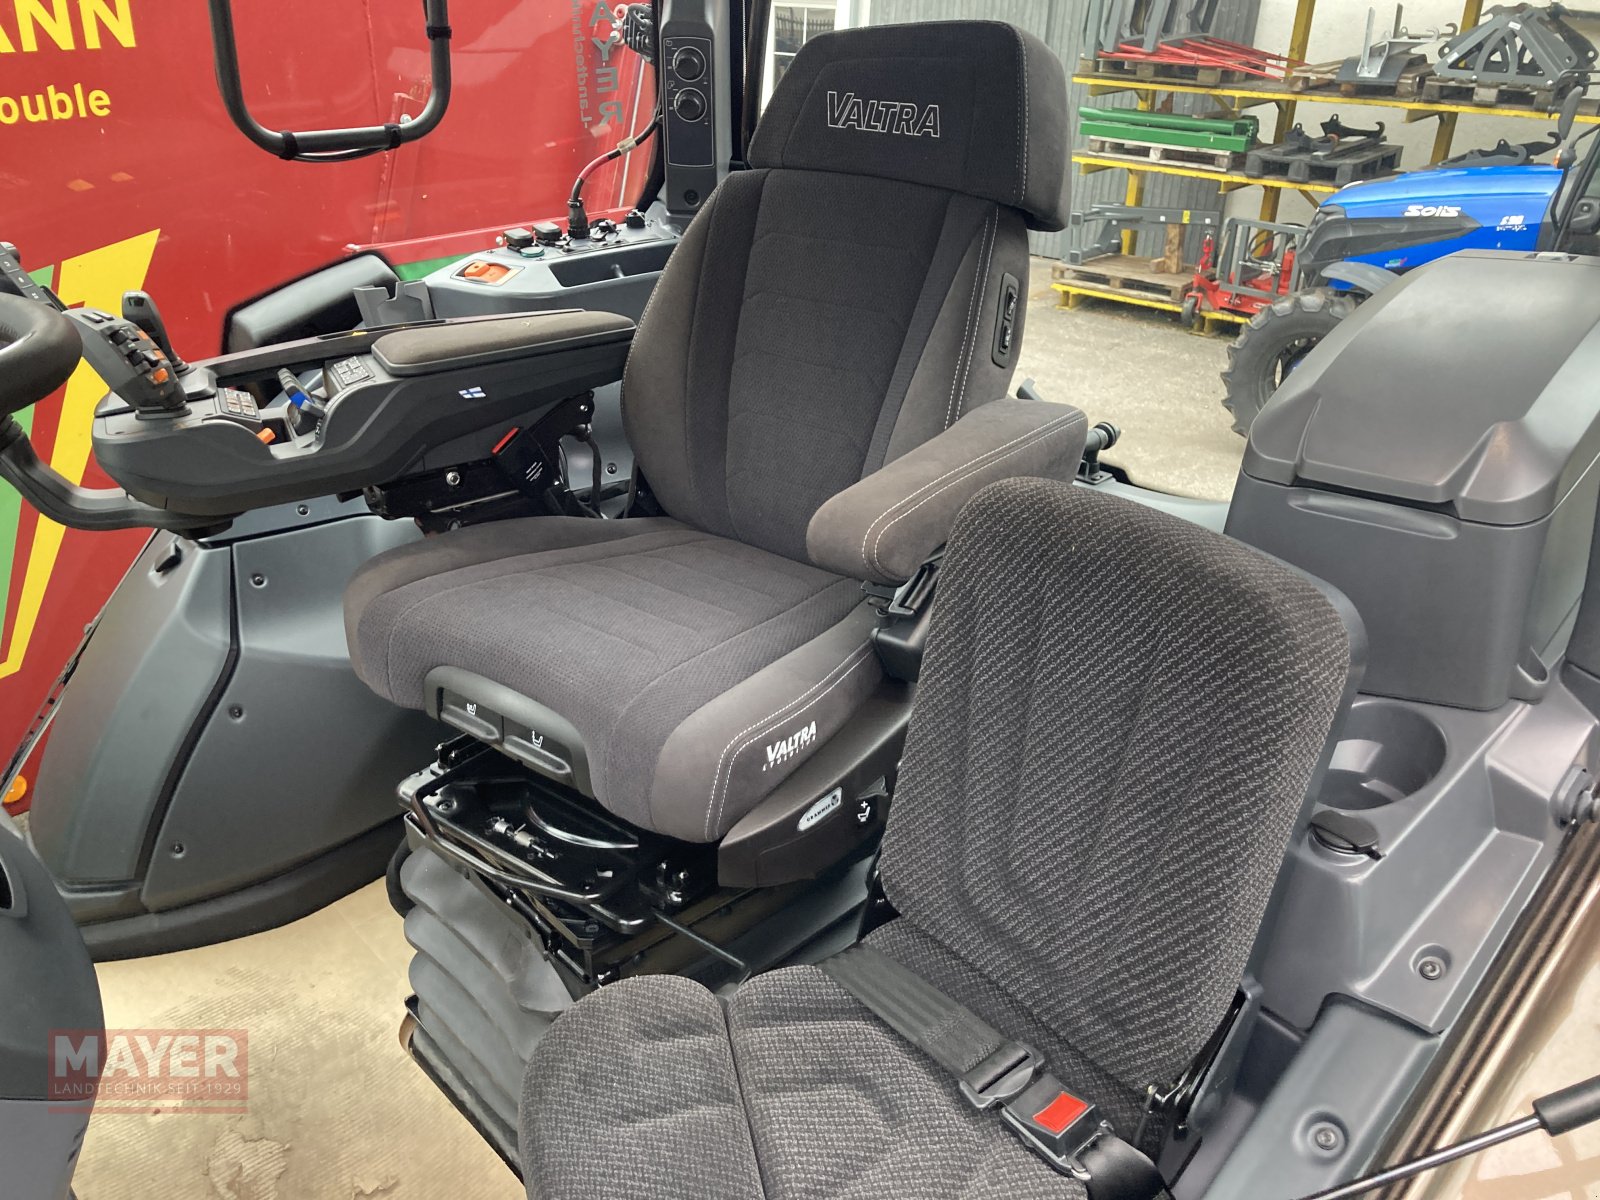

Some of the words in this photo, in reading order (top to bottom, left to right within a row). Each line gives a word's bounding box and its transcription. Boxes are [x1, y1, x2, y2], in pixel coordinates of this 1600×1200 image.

[0, 0, 136, 53] NN
[827, 91, 940, 138] VALTRA
[766, 721, 817, 762] VALTRA
